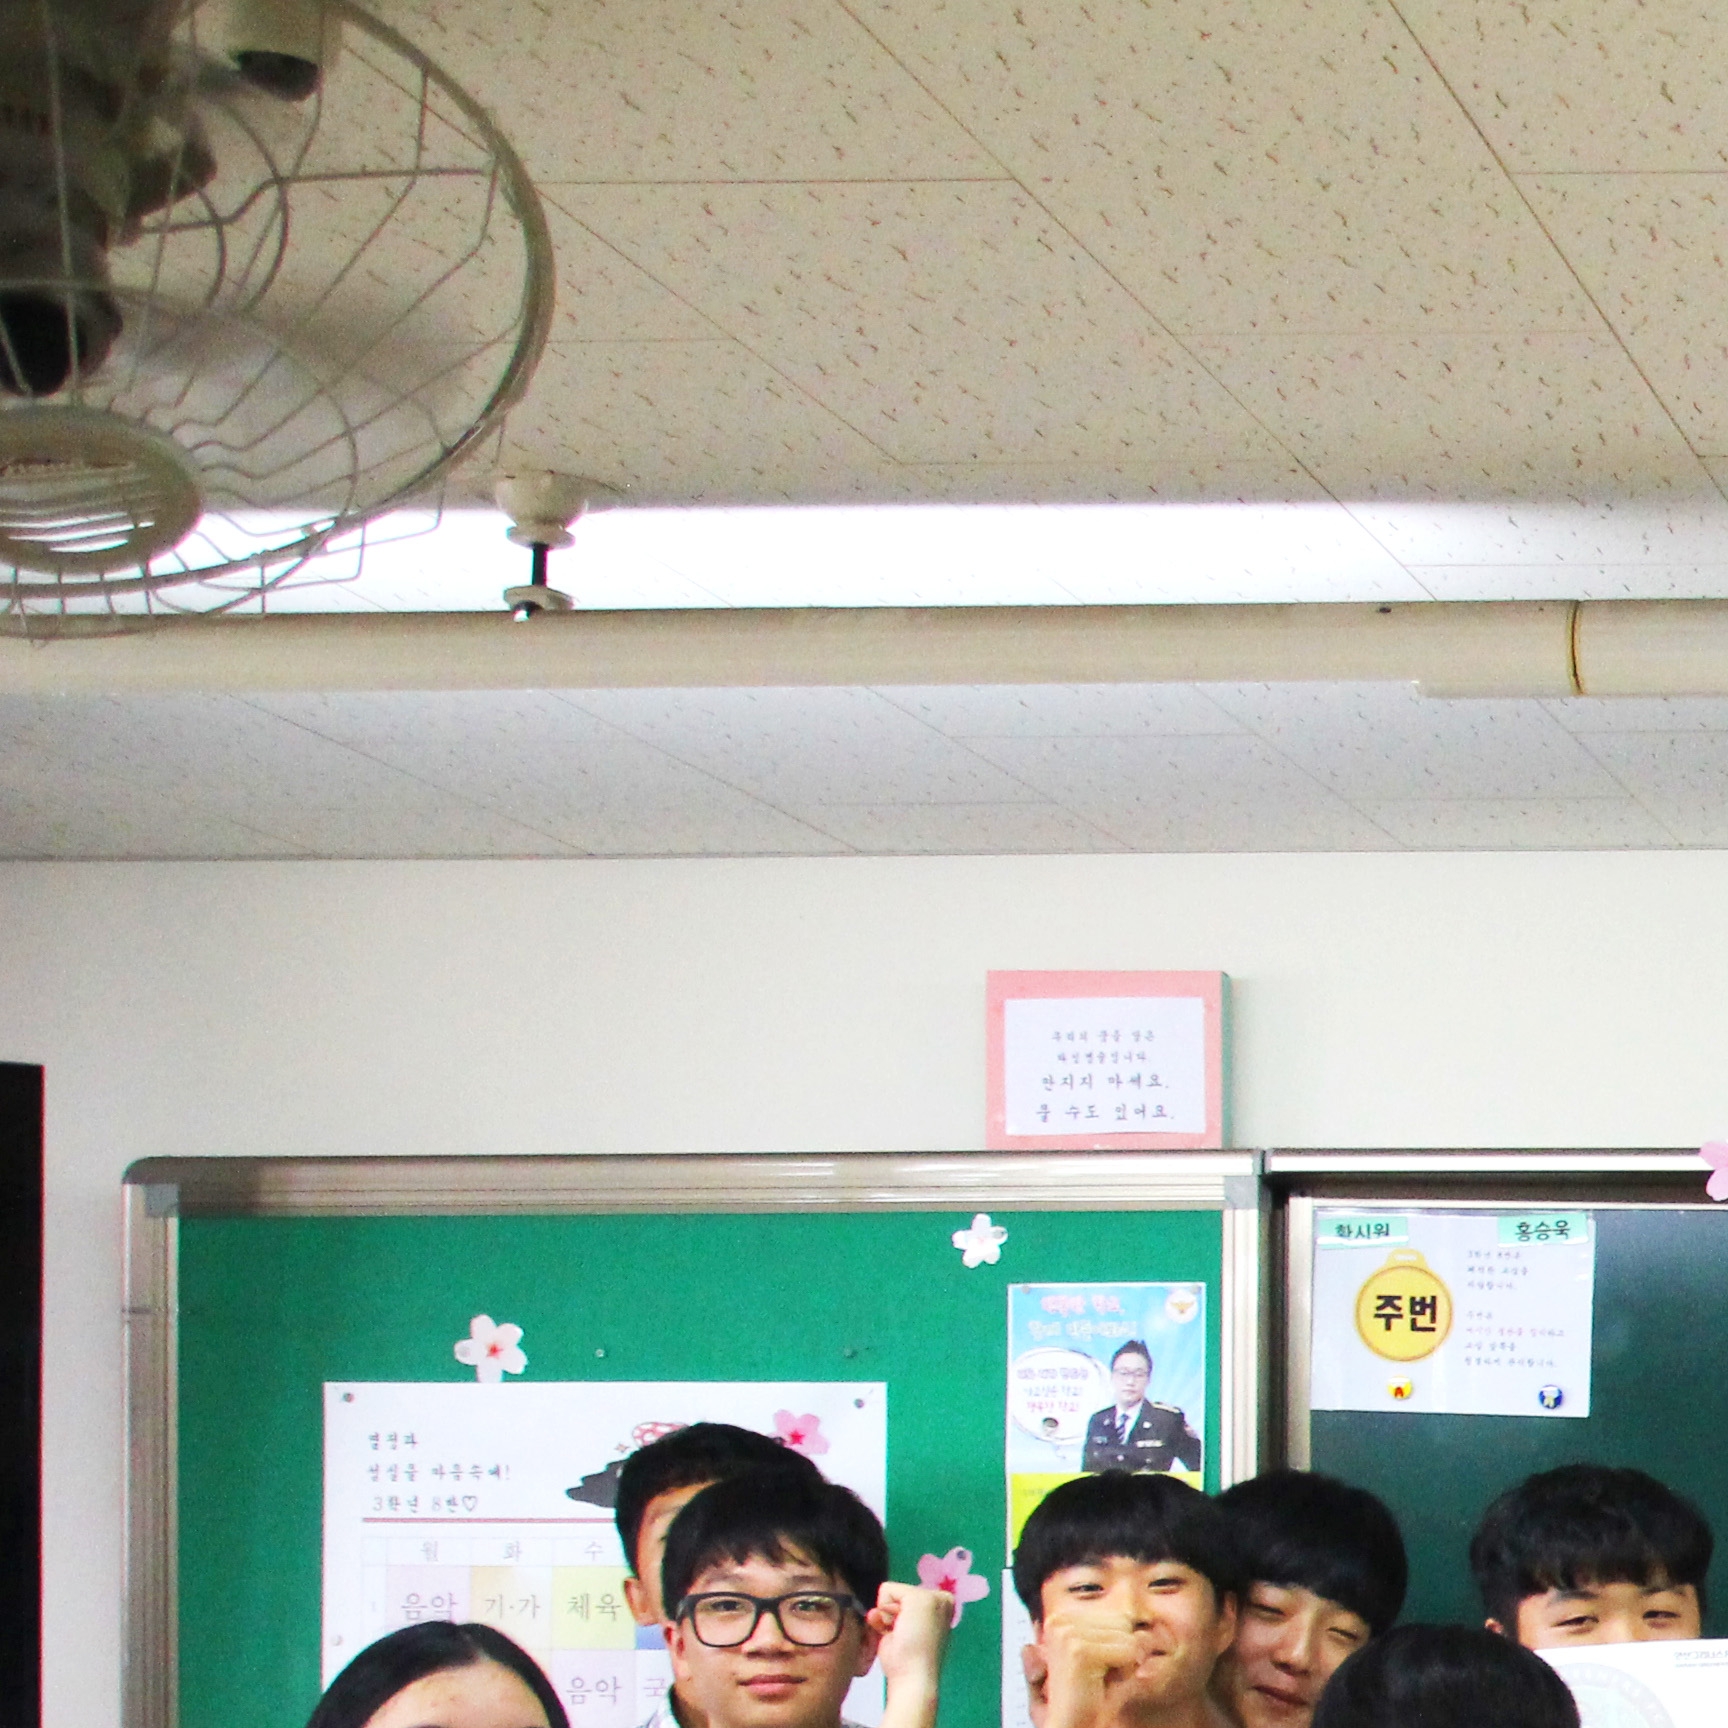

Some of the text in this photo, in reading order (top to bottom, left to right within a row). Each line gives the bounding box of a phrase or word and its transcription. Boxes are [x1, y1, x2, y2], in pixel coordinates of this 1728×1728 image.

[1042, 1072, 1168, 1091] 만지지 마세요.
[1065, 1104, 1099, 1120] 수도
[1115, 1102, 1175, 1122] 있어요.
[1515, 1219, 1571, 1242] 홍승욱
[1373, 1295, 1438, 1333] 주번
[431, 1463, 510, 1482] 마음속에!
[373, 1495, 419, 1513] 3학년
[420, 1541, 603, 1562] 월 화 수
[401, 1593, 459, 1621] 음악
[568, 1594, 623, 1620] 체육
[566, 1676, 621, 1705] 음악
